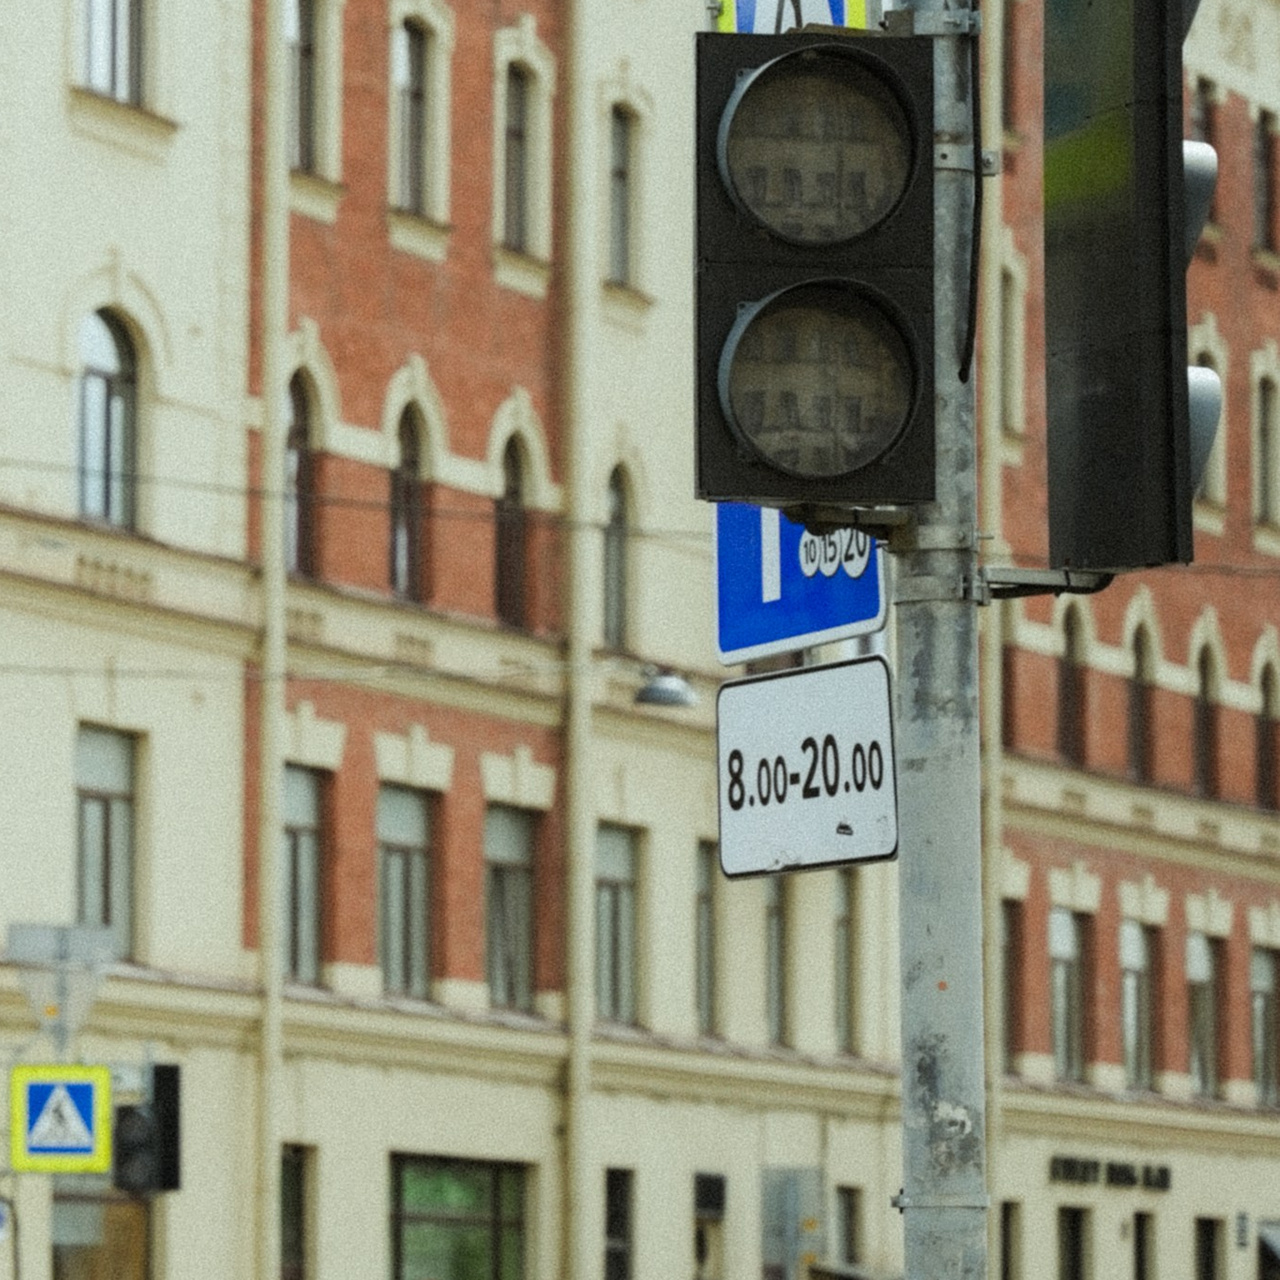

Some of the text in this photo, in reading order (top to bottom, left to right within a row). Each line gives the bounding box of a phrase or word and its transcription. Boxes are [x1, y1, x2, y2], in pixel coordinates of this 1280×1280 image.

[803, 528, 868, 565] 10 15 20
[728, 733, 883, 811] 8.00-20.00
